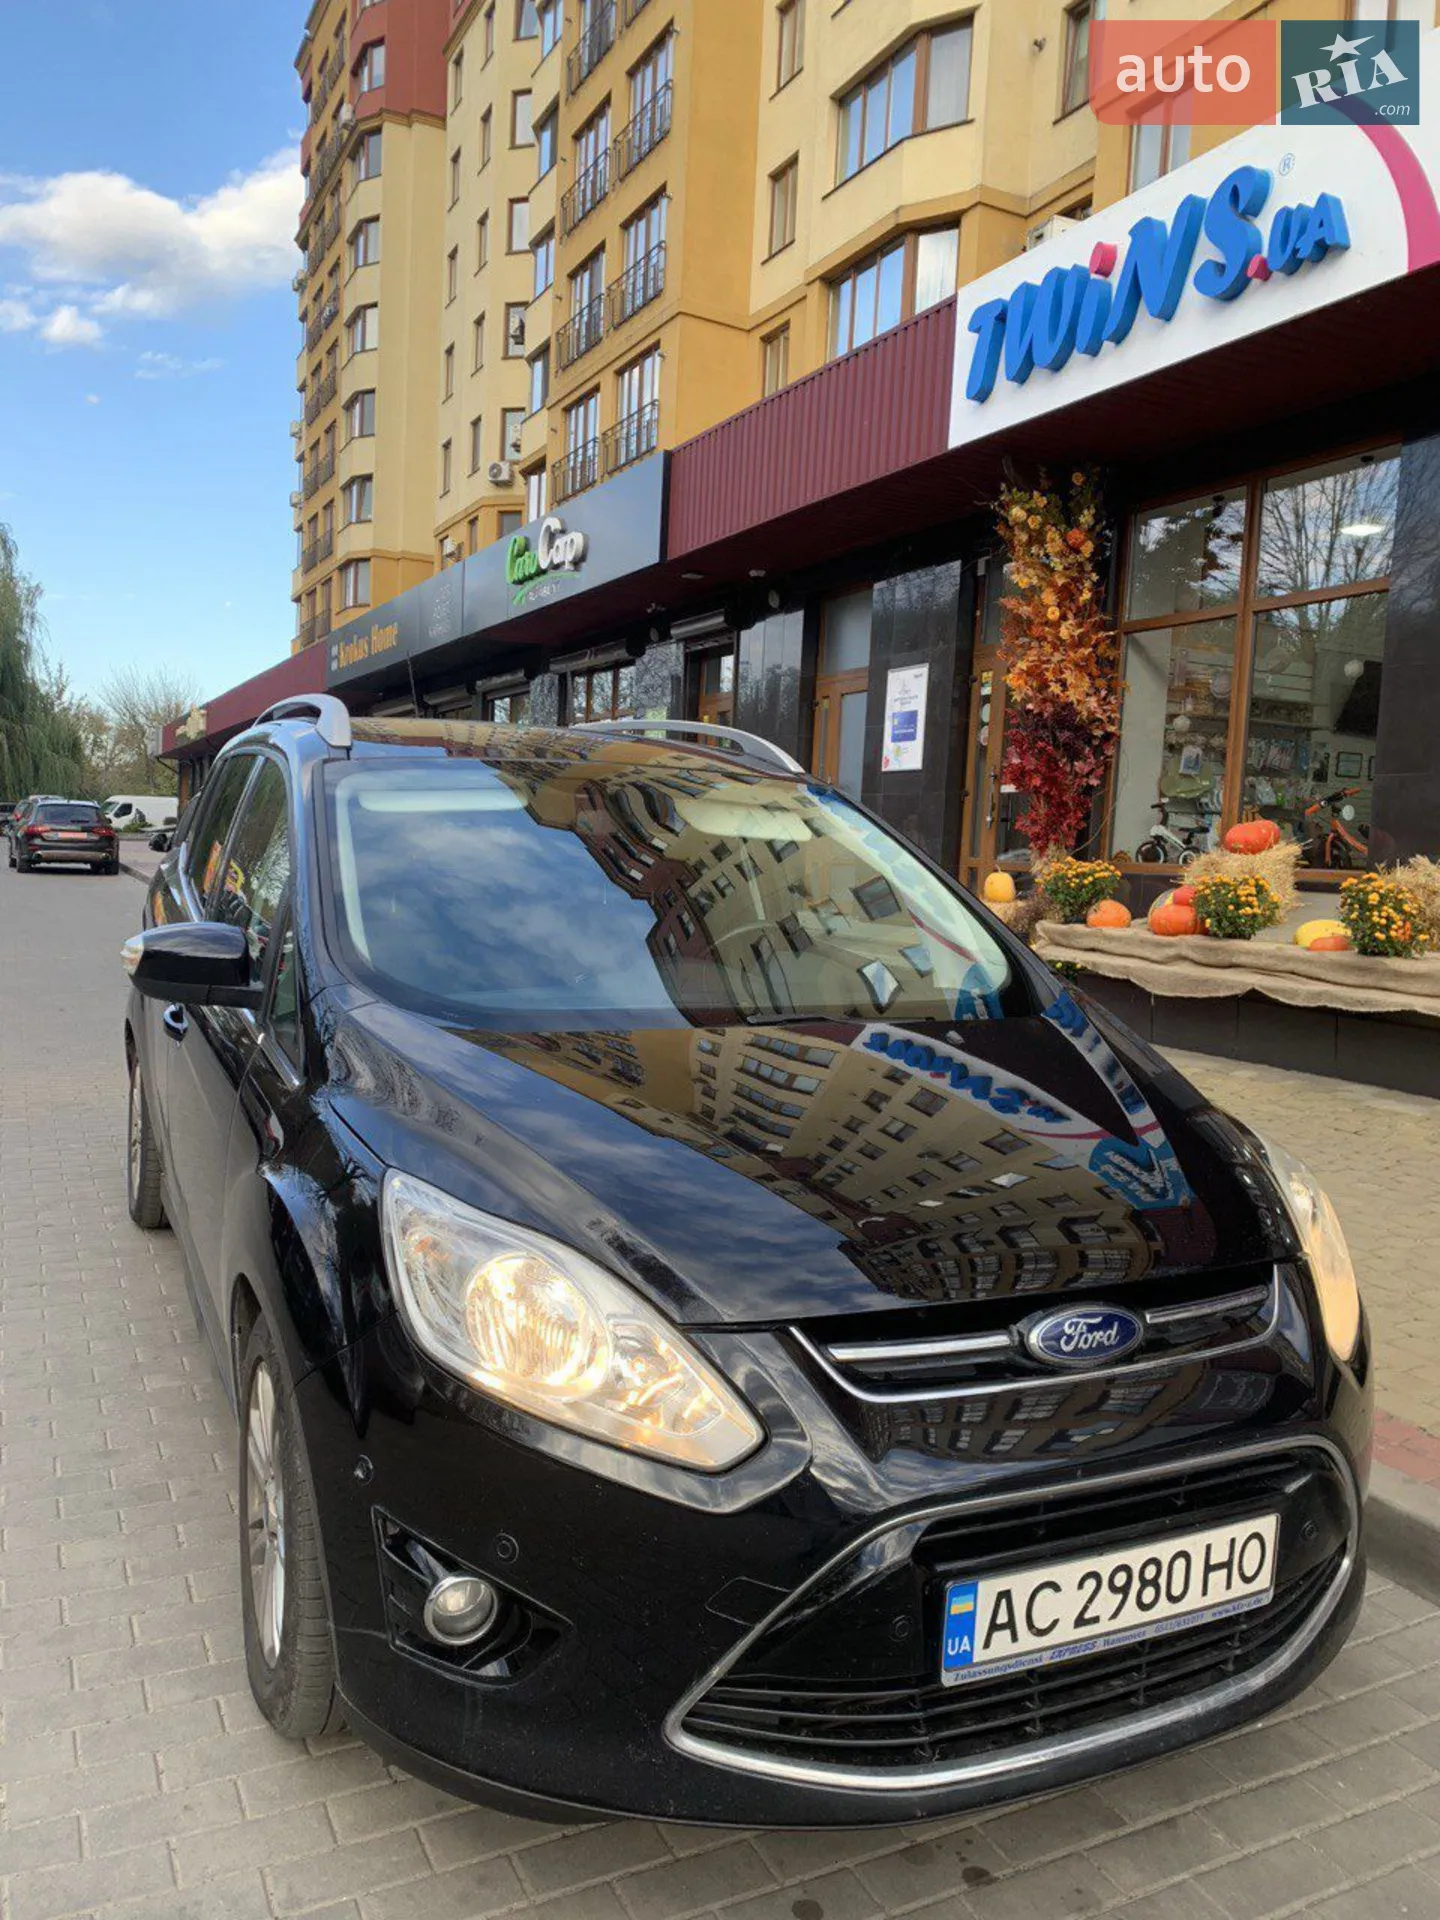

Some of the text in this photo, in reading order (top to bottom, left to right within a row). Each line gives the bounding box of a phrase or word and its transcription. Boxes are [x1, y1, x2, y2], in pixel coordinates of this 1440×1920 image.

[1060, 1316, 1120, 1353] Ford
[1073, 1549, 1192, 1630] 2980
[947, 1635, 972, 1656] UA
